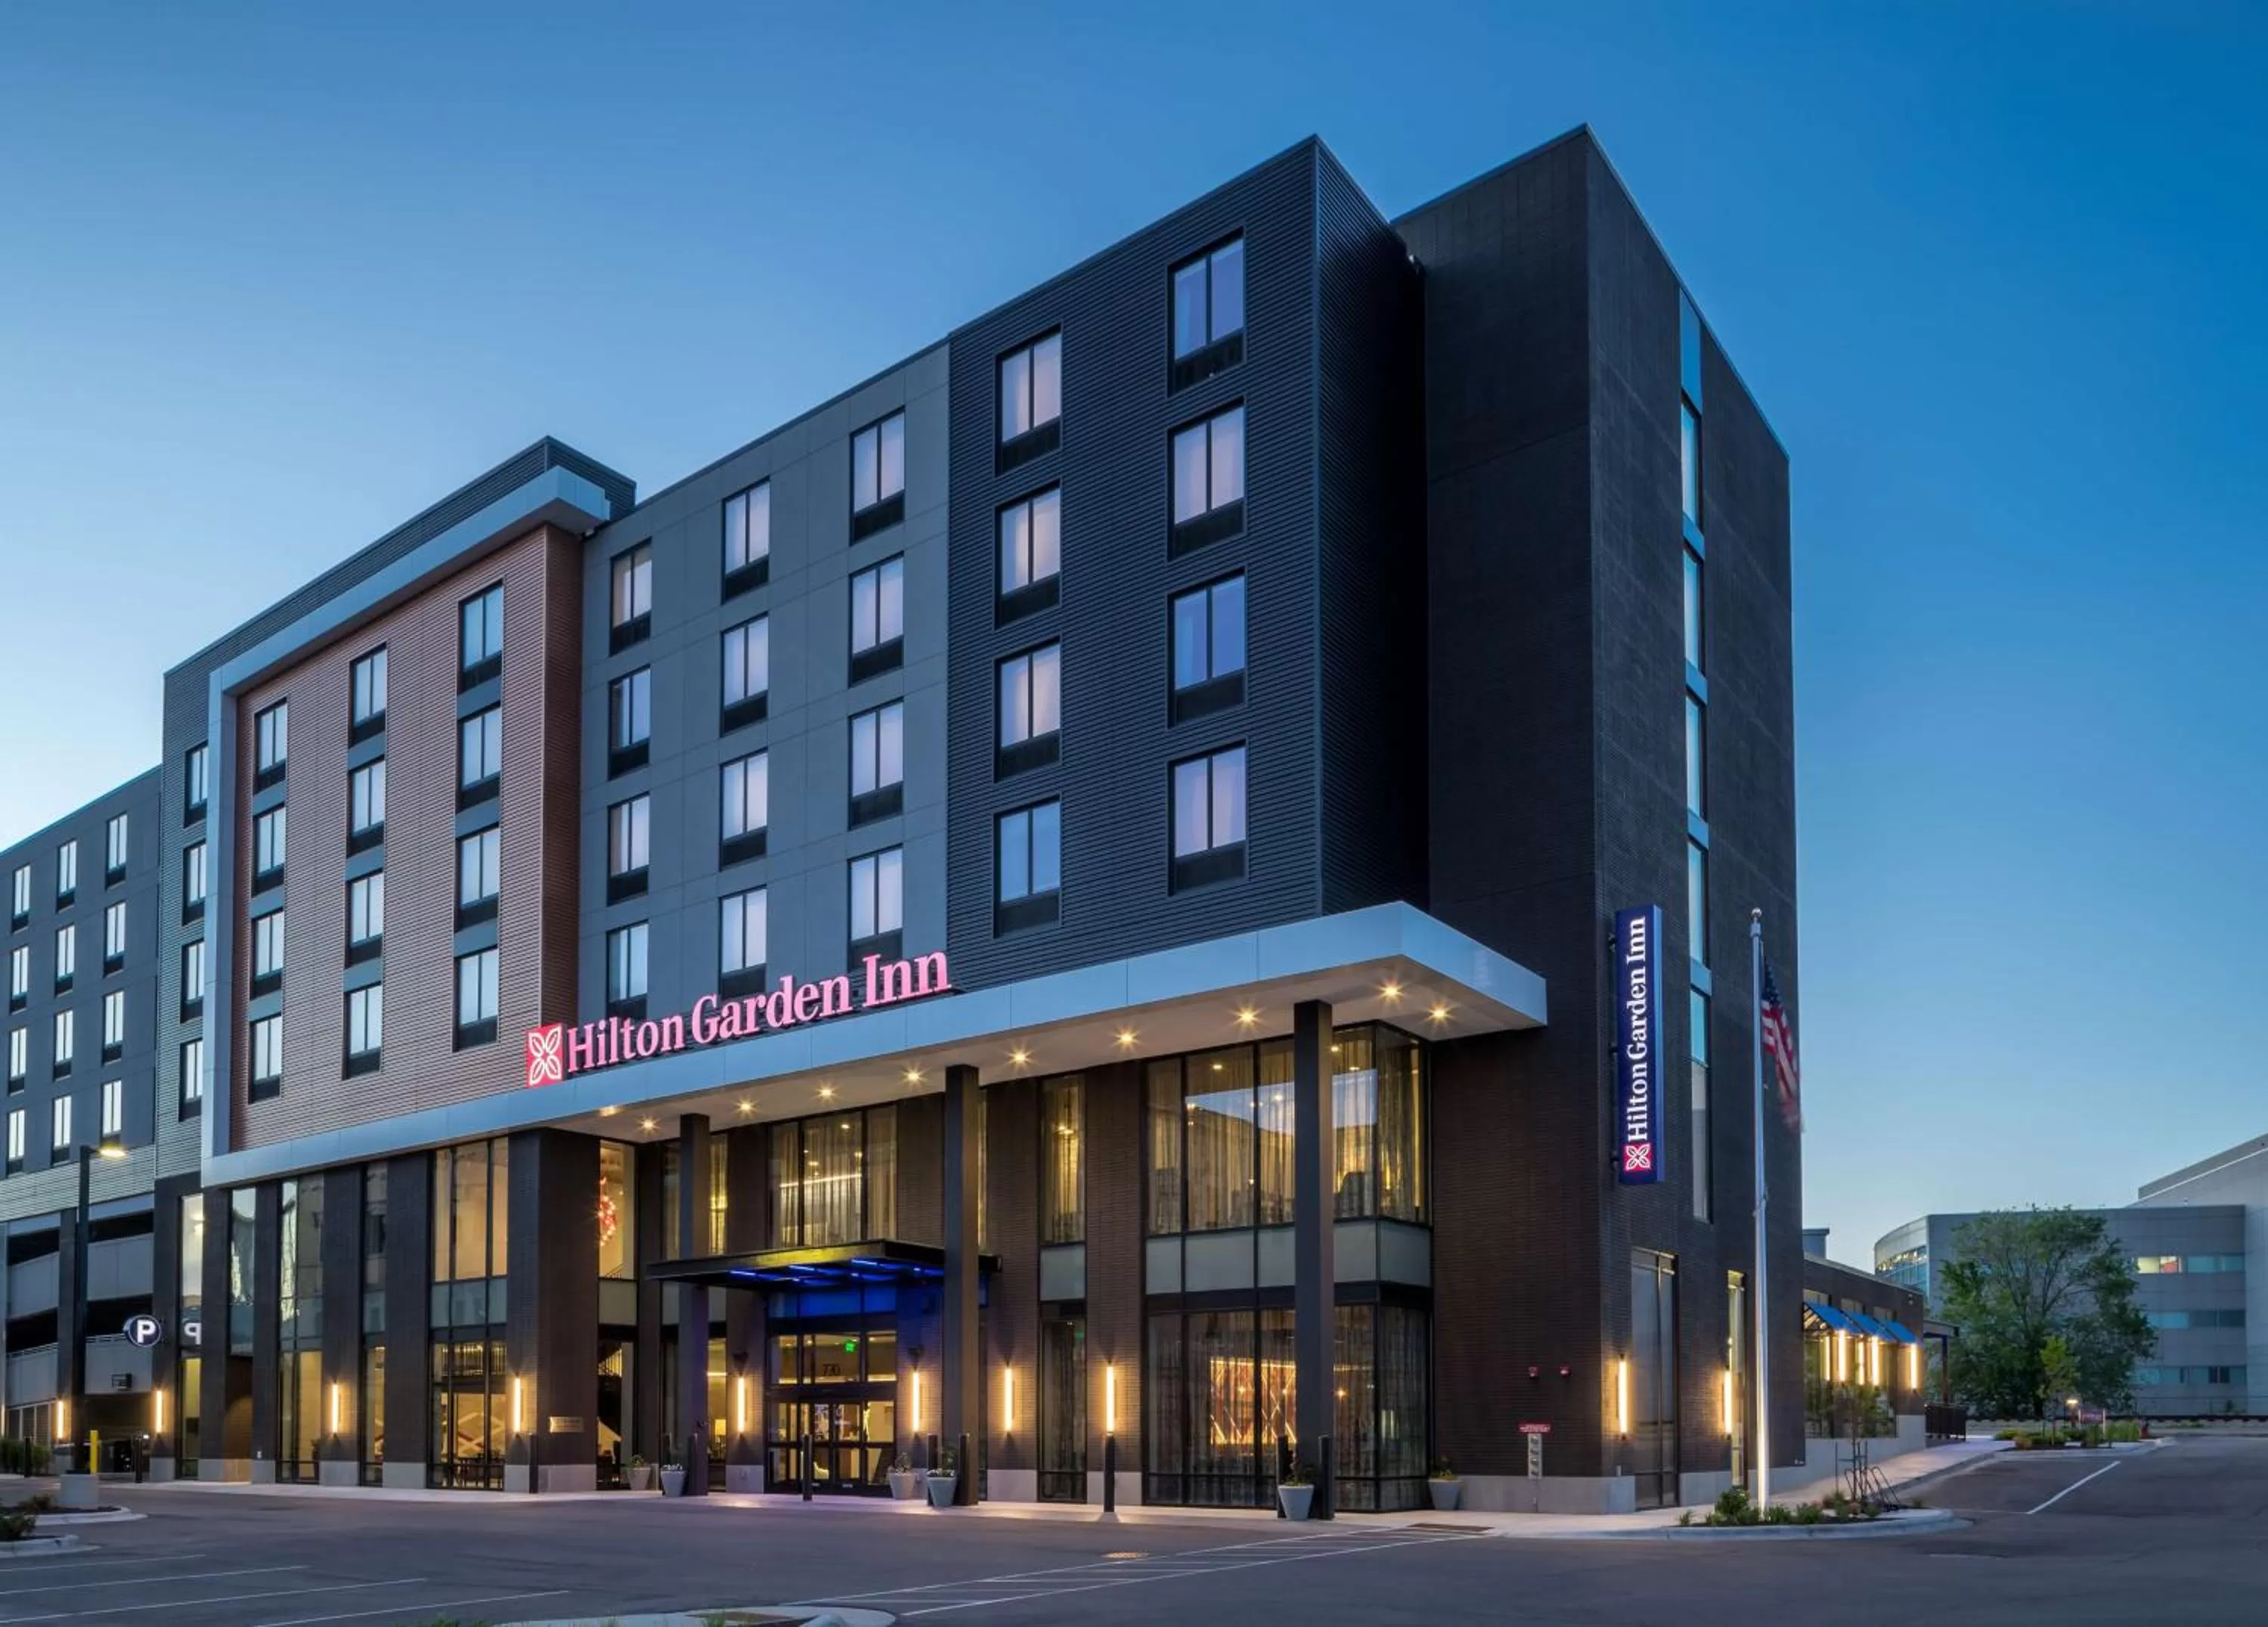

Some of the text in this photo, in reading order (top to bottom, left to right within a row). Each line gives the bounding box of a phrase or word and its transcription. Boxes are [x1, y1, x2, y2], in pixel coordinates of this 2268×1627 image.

[567, 951, 950, 1072] Hilton Garden Inn
[1626, 916, 1647, 1142] Hilton Garden Inn
[137, 1319, 156, 1343] P
